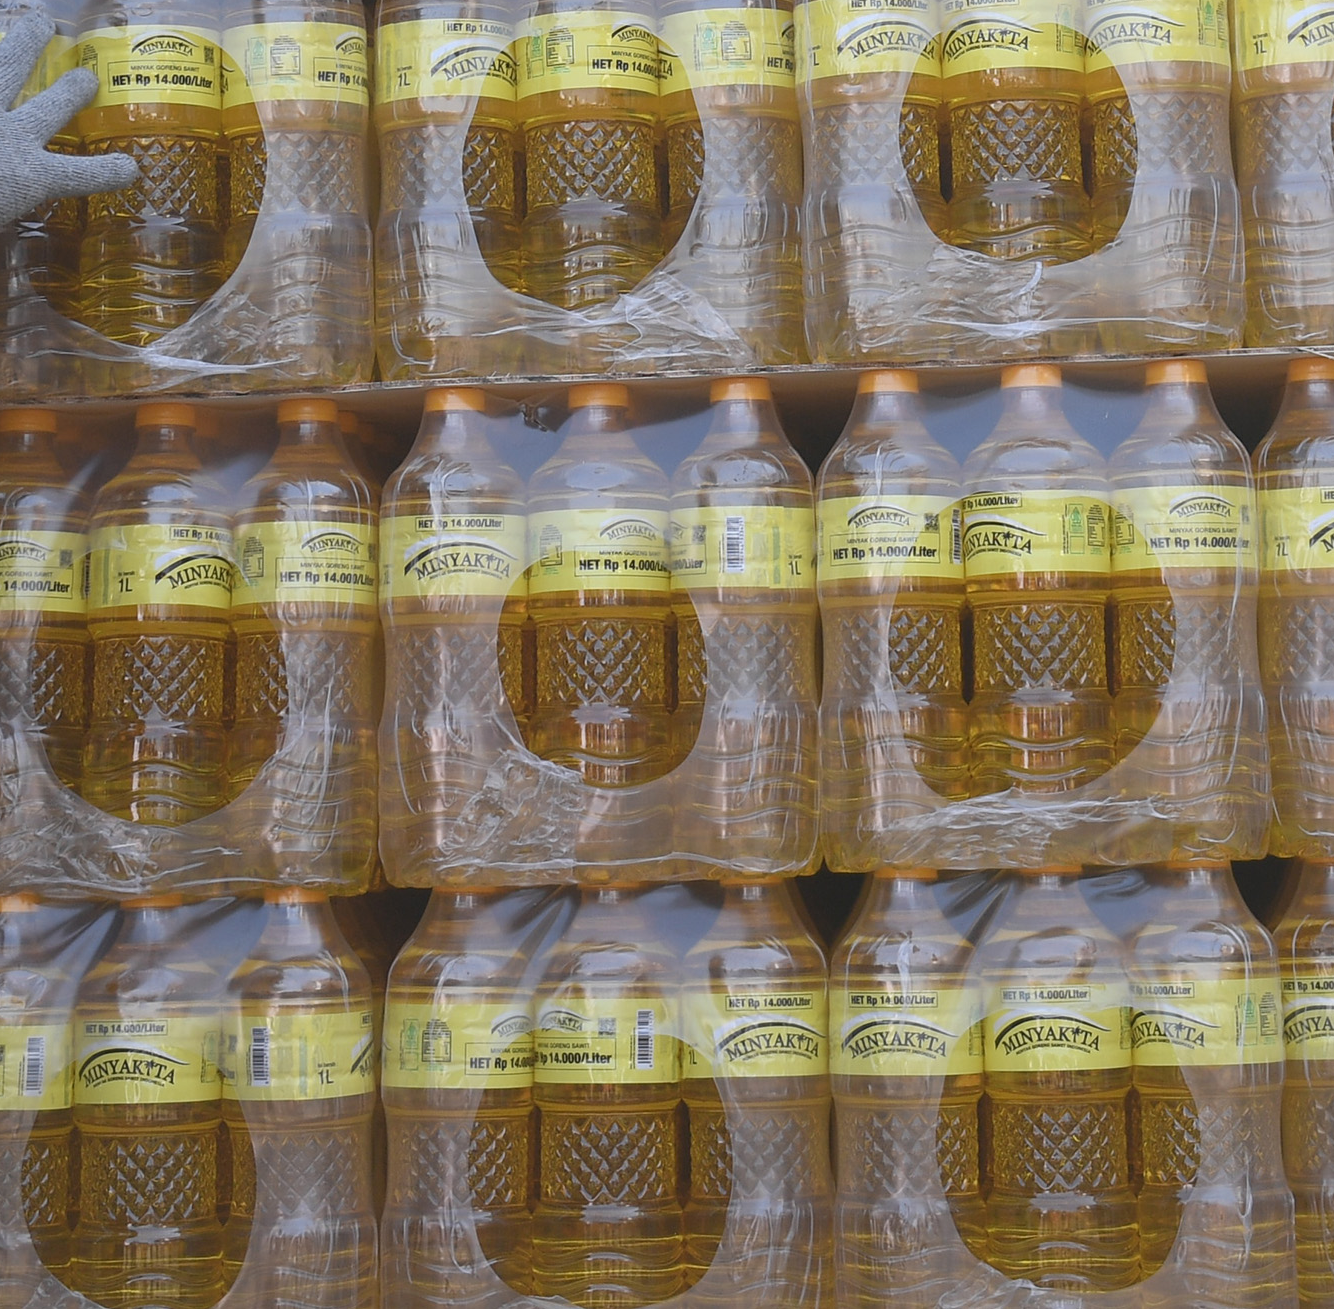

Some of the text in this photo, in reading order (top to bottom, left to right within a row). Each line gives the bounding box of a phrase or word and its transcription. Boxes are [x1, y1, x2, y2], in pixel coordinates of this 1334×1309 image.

[138, 42, 194, 57] MINYAKITA
[593, 58, 629, 73] HET Rp
[112, 73, 212, 90] HET Rp 14.000/Liter
[418, 518, 502, 529] HET 14.000/Liter
[853, 513, 910, 528] MINYAKITA
[1150, 537, 1190, 550] HET Rp
[833, 546, 937, 561] HET Rp 14.000/Liter
[416, 553, 510, 580] MINYAKITA
[280, 571, 320, 585] HET Rp
[3, 580, 70, 594] 14.000/Liter
[851, 995, 877, 1007] HET Rp
[1034, 988, 1089, 1001] 14.000/Liter
[729, 998, 760, 1010] HET Rp
[111, 1021, 165, 1034] 14.000/Liter
[727, 1032, 819, 1063] MINYAKITA
[850, 1031, 947, 1060] MINYAKITA
[1002, 1026, 1101, 1057] MINYAKITA
[84, 1060, 175, 1088] MINYAKITA
